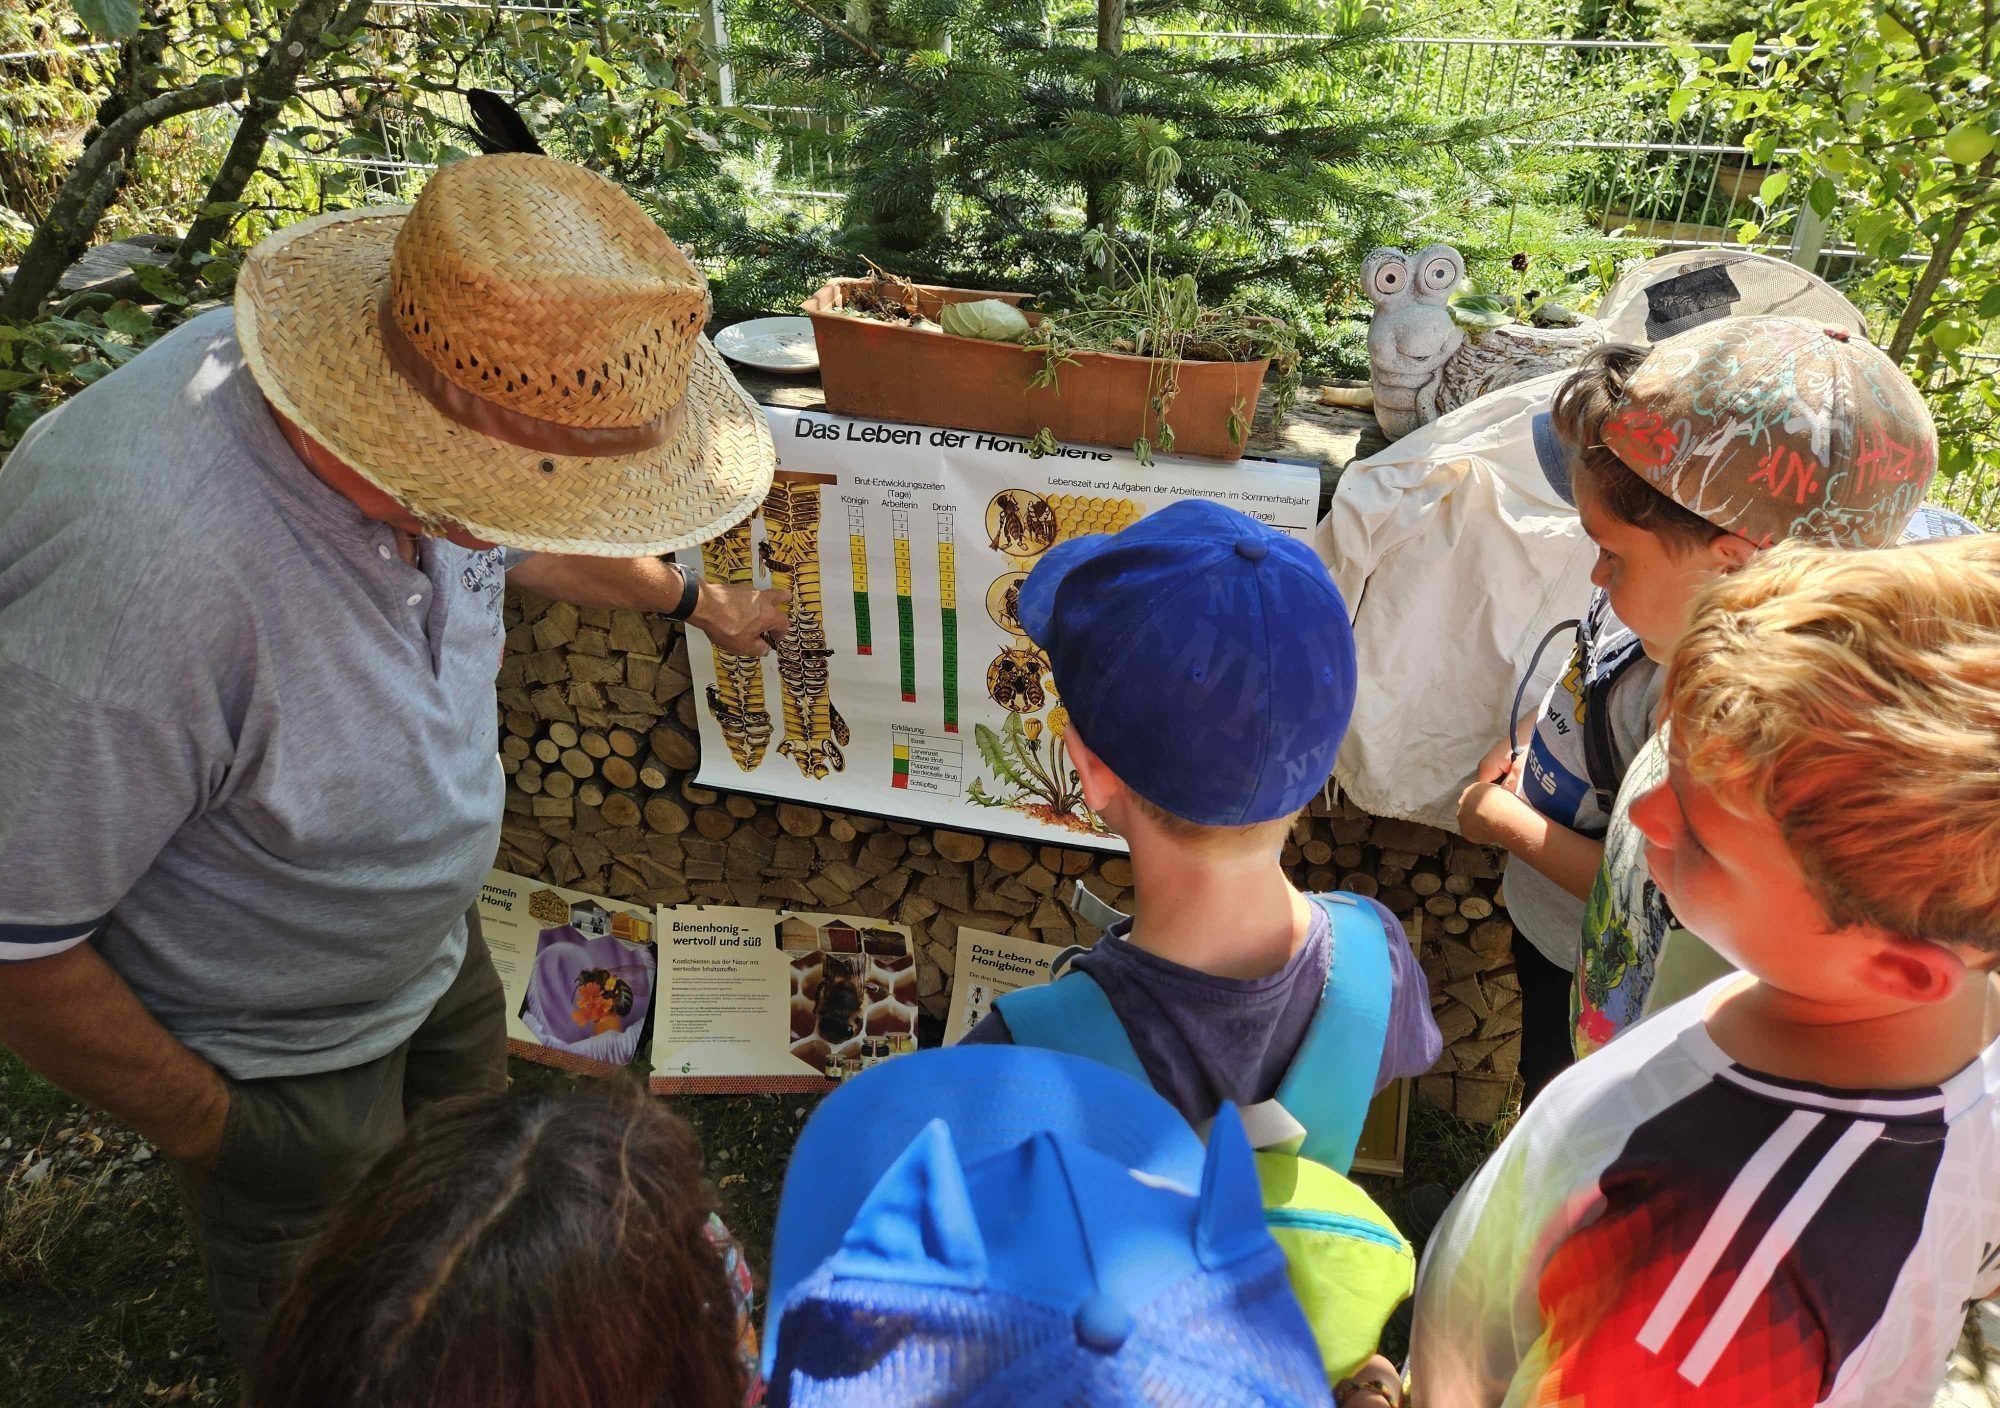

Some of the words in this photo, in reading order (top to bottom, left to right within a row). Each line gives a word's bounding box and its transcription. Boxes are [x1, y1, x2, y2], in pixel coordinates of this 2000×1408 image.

[795, 418, 840, 441] Das
[846, 422, 921, 445] Leben
[929, 429, 970, 448] der
[975, 434, 1112, 462] Honiene
[854, 476, 946, 491] Brut-Entwicklungszeiten
[1048, 475, 1092, 489] Lebenszeit
[1094, 480, 1109, 490] und
[1112, 481, 1151, 494] Aufgaben
[1153, 484, 1168, 494] der
[1170, 486, 1226, 499] Arbeiterinnen
[1228, 490, 1239, 500] im
[1241, 491, 1310, 506] Sommerhalbjahr
[841, 495, 869, 506] Königin
[887, 489, 912, 500] (Tage)
[881, 499, 918, 510] Arbeiterin
[932, 502, 957, 512] Drohn
[1248, 510, 1276, 522] (Tage)
[1547, 705, 1562, 722] ed
[1556, 718, 1571, 735] by
[1528, 748, 1544, 782] SSE
[482, 884, 517, 899] mmeln
[481, 894, 513, 912] Honig
[672, 921, 739, 936] Bienenhonig
[673, 936, 717, 946] wertvoll
[720, 937, 740, 947] und
[743, 937, 762, 947] süß
[971, 944, 995, 956] Das
[997, 950, 1032, 964] Leben
[1035, 958, 1051, 969] de
[971, 955, 1035, 976] Honigbiene
